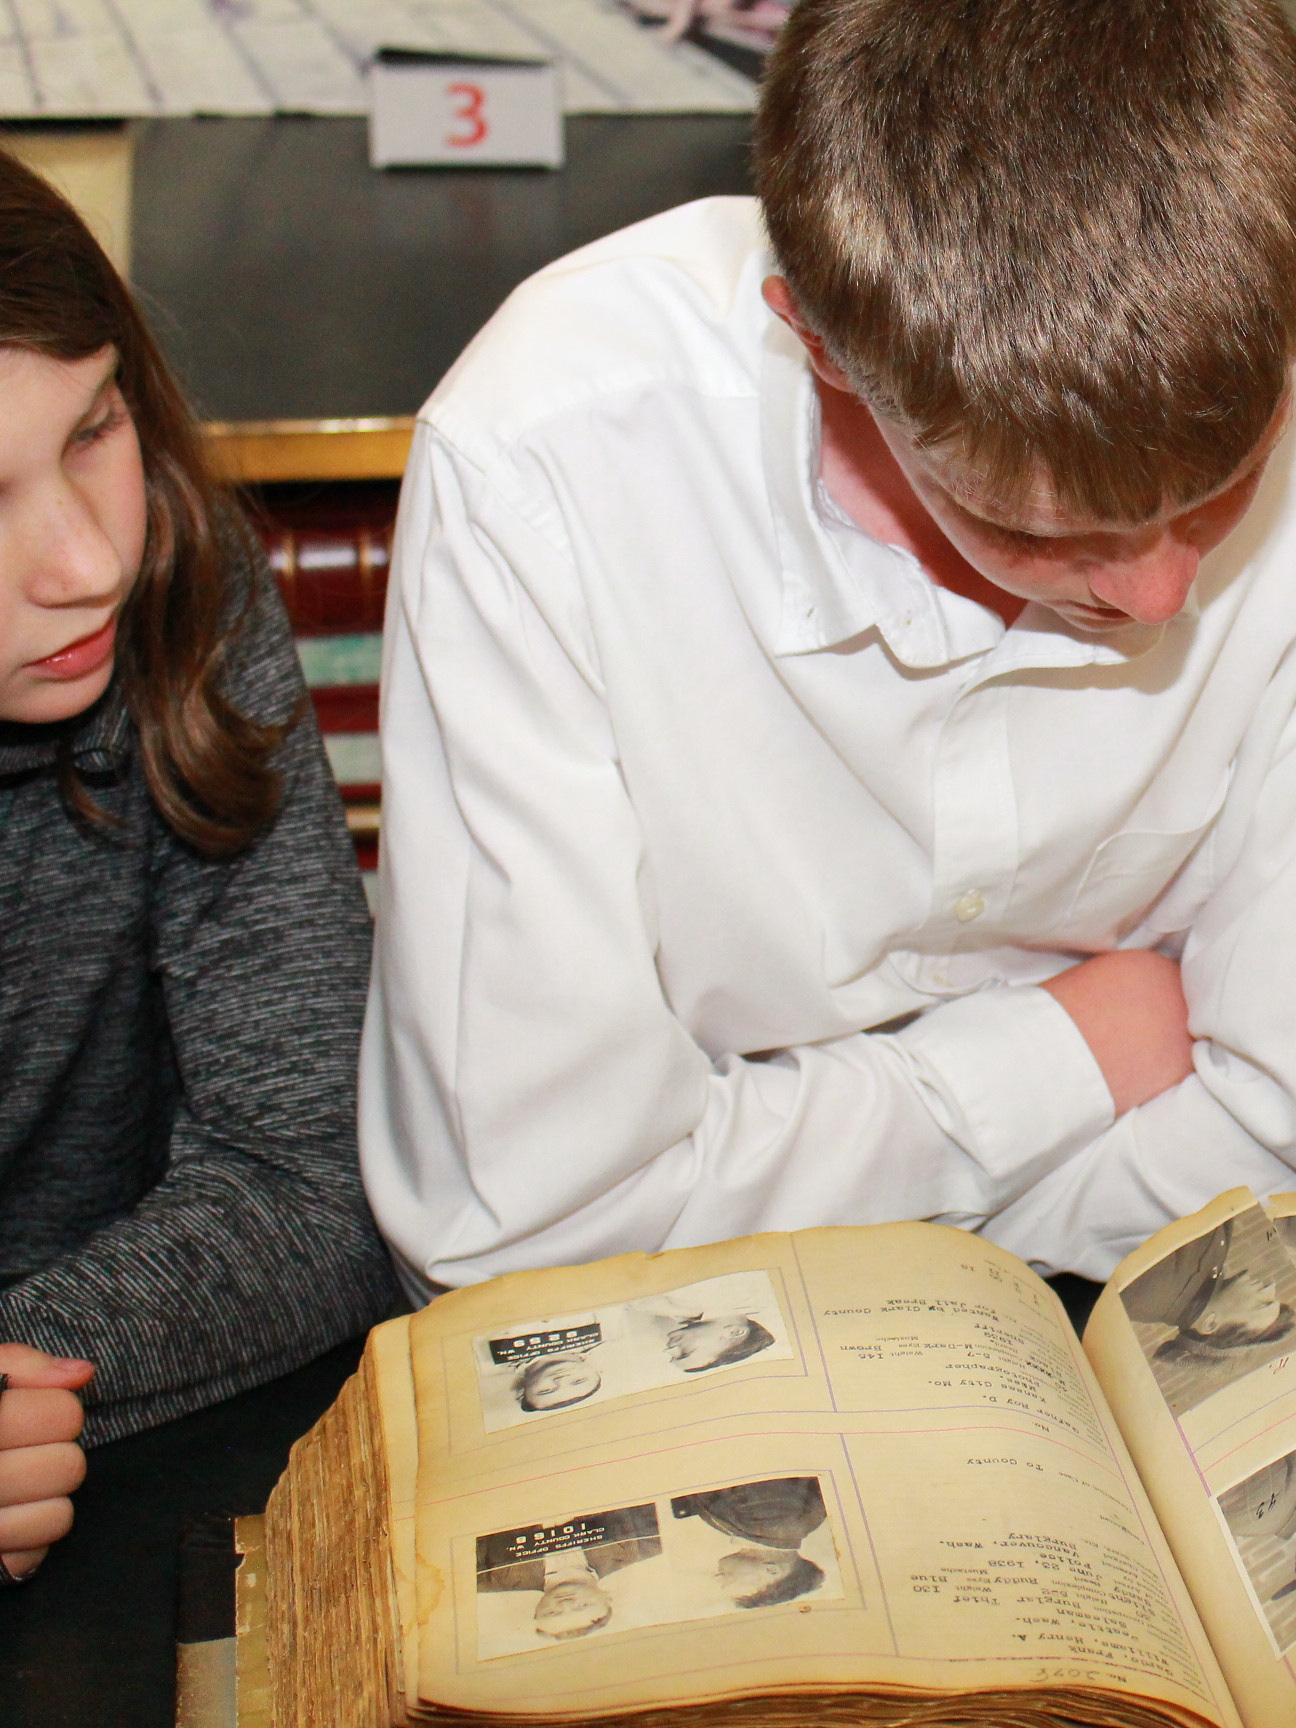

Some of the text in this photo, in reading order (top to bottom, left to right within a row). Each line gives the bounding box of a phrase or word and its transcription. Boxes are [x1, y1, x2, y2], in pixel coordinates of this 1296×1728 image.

[447, 83, 489, 148] 3
[823, 1308, 872, 1316] County
[952, 1307, 1000, 1322] Wanted
[974, 1323, 1025, 1345] Sheriff
[526, 1340, 563, 1351] COUNTY
[945, 1363, 1040, 1387] Photographer
[960, 1379, 993, 1388] City
[982, 1395, 998, 1403] D.
[1000, 1384, 1046, 1404] Kansas
[1007, 1398, 1029, 1410] Roy
[967, 1458, 1044, 1472] To County
[573, 1527, 605, 1537] CLARK
[515, 1535, 603, 1557] SHERIFFS OFFICE
[534, 1535, 570, 1546] COUNTY
[1008, 1532, 1077, 1550] Burglary
[939, 1541, 1080, 1558] Vancouver, Wash.
[1040, 1553, 1092, 1570] Police
[910, 1575, 948, 1583] Blue
[994, 1576, 1039, 1585] Ruddy
[955, 1585, 992, 1593] Weight
[953, 1596, 1000, 1606] Thief
[1016, 1596, 1081, 1609] Burglar
[1016, 1617, 1061, 1626] Wash.
[1056, 1609, 1127, 1629] Salesman
[1012, 1633, 1170, 1666] Williams, Henry A.
[1068, 1645, 1114, 1660] Frank
